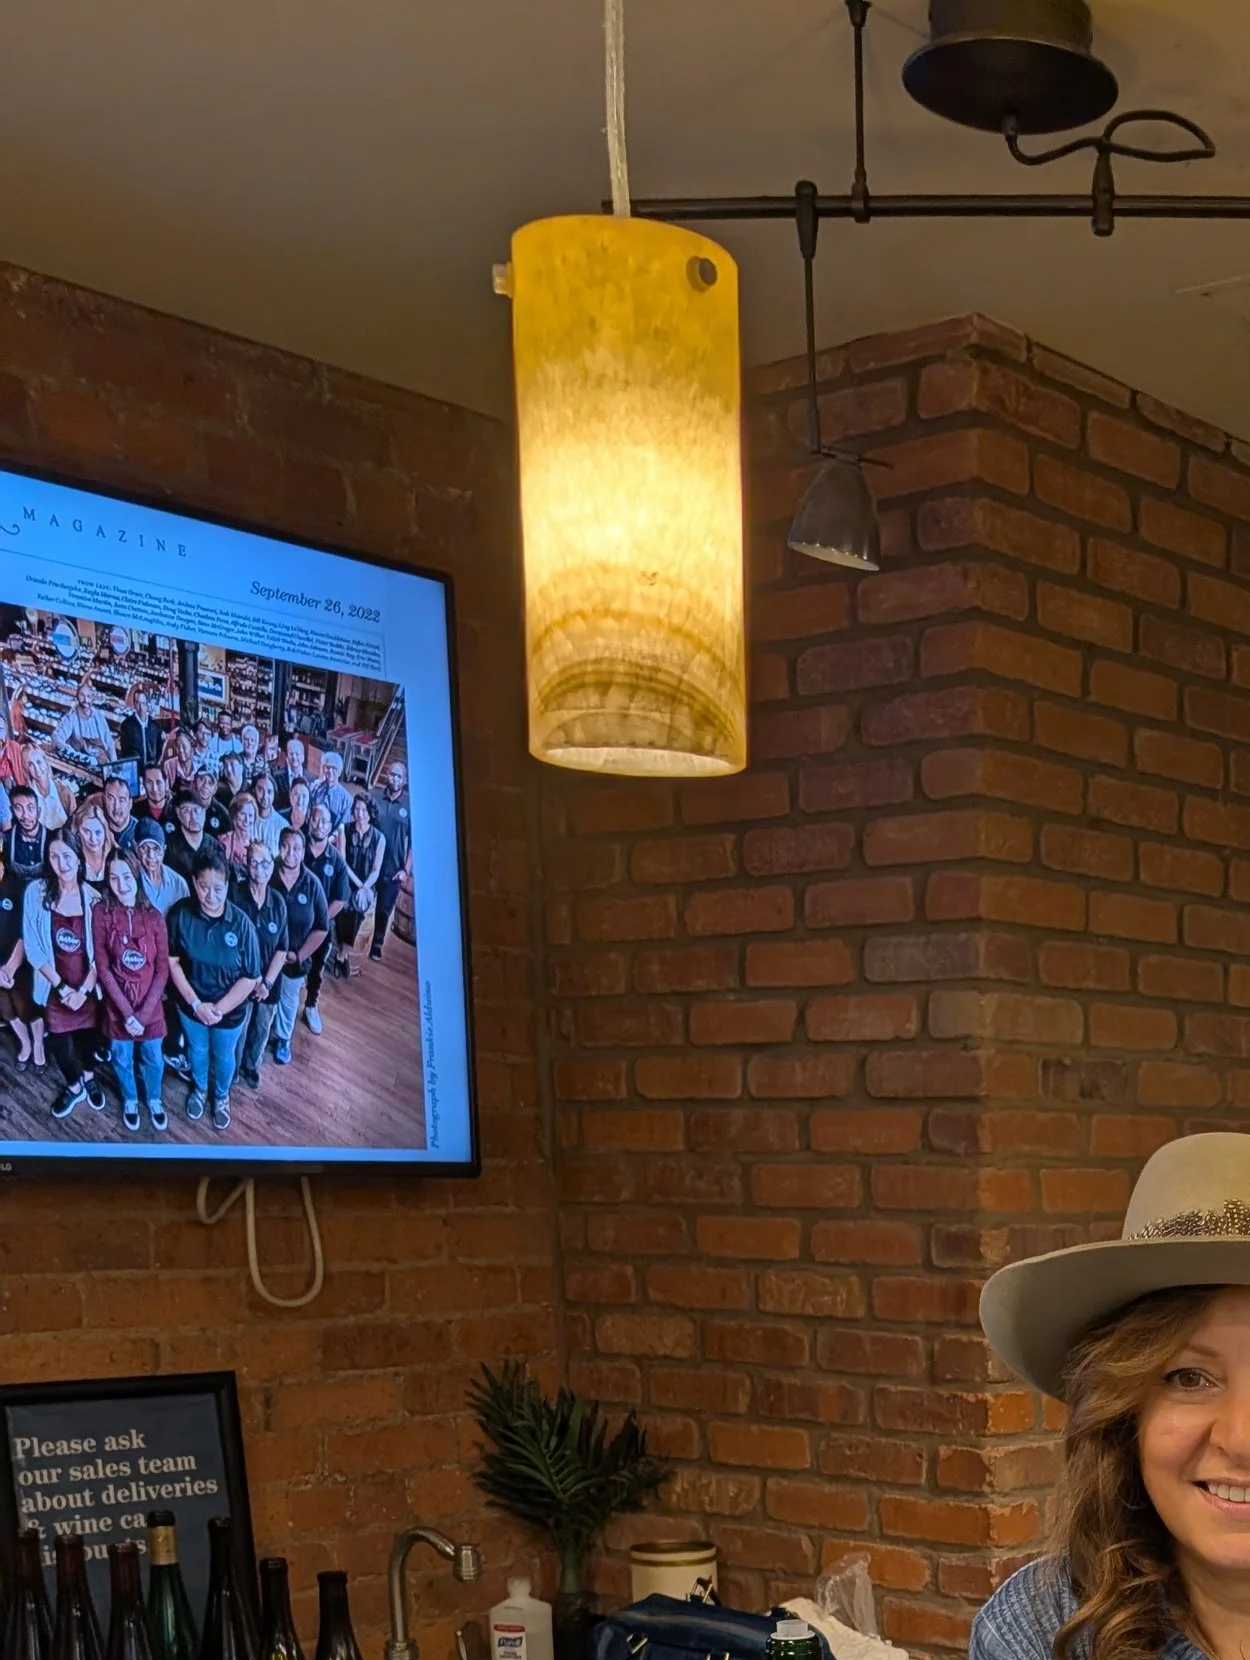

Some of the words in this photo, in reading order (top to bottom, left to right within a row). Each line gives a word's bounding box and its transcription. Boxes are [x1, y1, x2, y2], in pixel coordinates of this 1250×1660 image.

[22, 506, 188, 558] MAGAZINE
[250, 580, 322, 609] September
[323, 599, 345, 617] 26,
[347, 604, 381, 623] 2022
[429, 1071, 438, 1085] by
[430, 1085, 440, 1150] Photograph
[13, 1437, 97, 1459] Please
[104, 1429, 147, 1451] ask
[18, 1467, 62, 1486] our
[69, 1459, 132, 1482] sales
[138, 1455, 198, 1475] team
[22, 1488, 95, 1513] about
[102, 1476, 219, 1505] deliveries
[53, 1514, 113, 1537] wine
